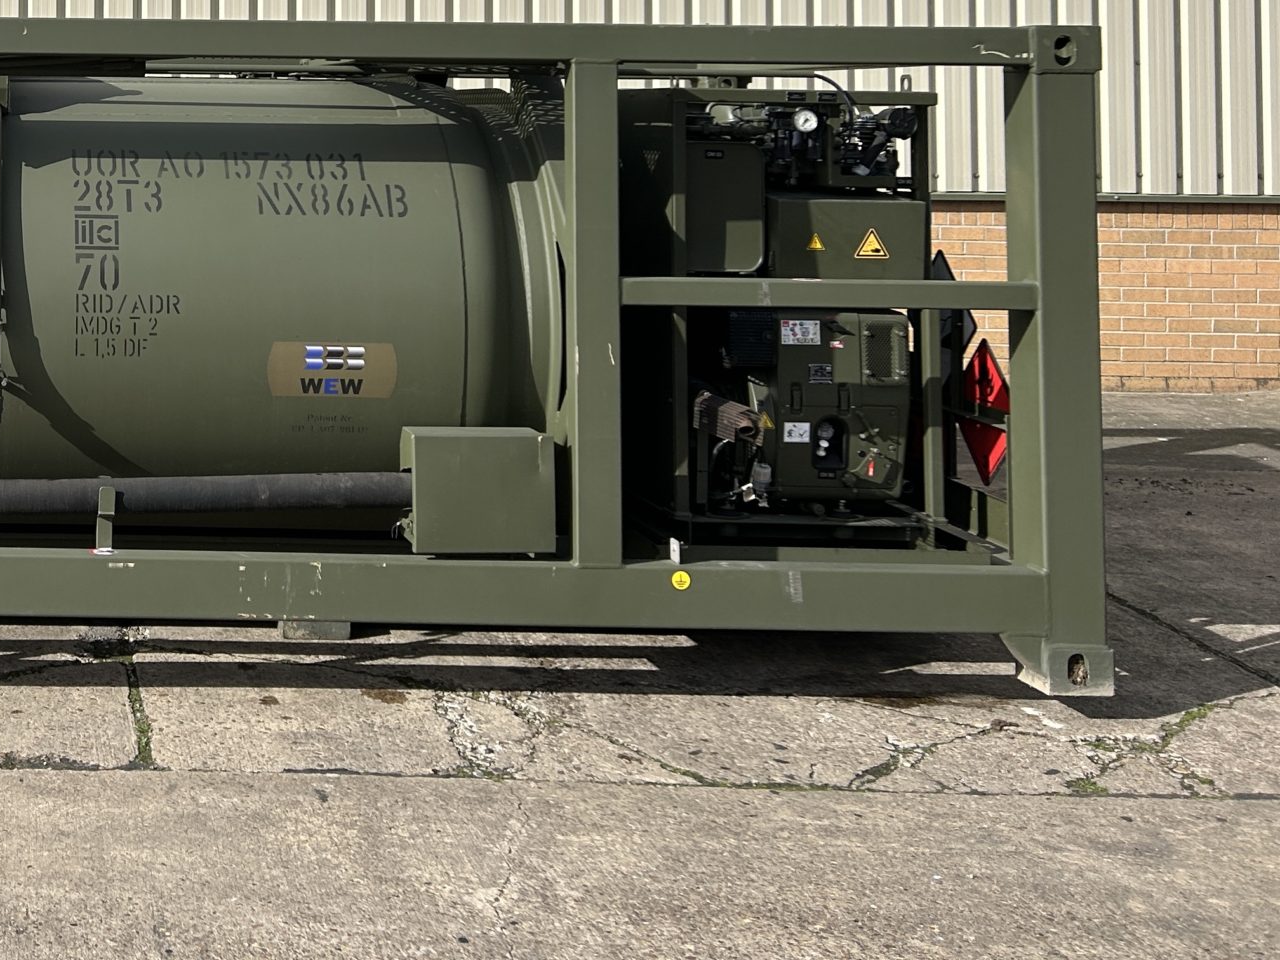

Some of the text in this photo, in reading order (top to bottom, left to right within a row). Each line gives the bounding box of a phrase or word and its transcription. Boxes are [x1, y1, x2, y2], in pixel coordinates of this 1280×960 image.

[72, 148, 141, 178] UOR
[220, 151, 294, 180] 1573
[73, 179, 163, 213] 28T3
[257, 182, 409, 218] NX86AB
[75, 253, 120, 291] 70
[75, 316, 121, 335] IMDG
[124, 338, 149, 357] DF
[300, 377, 363, 394] WEW
